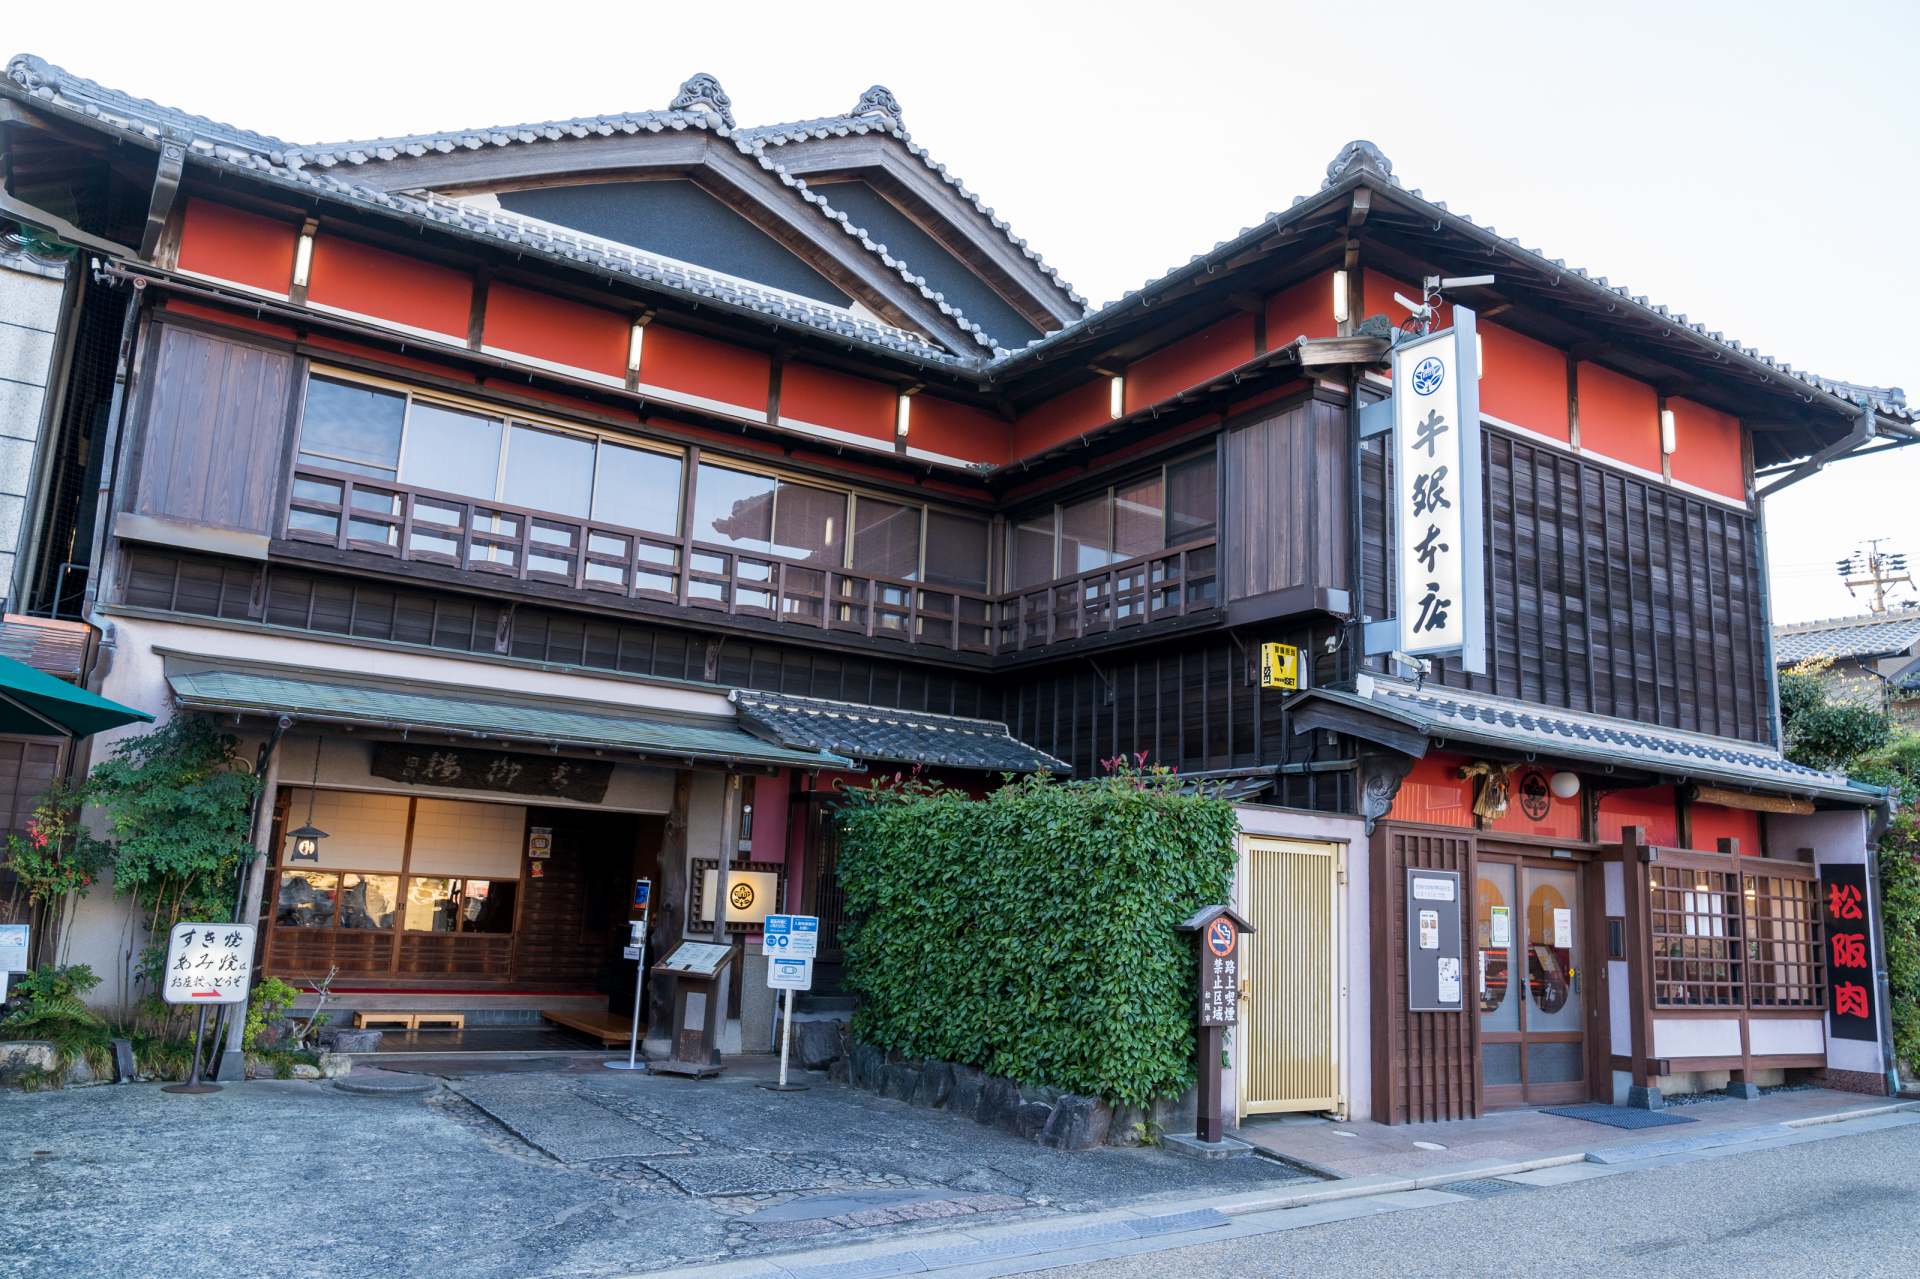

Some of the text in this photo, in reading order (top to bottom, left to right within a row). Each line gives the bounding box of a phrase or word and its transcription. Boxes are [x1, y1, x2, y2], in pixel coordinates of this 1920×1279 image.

[1411, 409, 1451, 634] 牛銀本店
[179, 928, 243, 948] すき焼
[1829, 884, 1869, 1018] 松阪肉
[1212, 958, 1223, 1021] 禁止区域
[1225, 960, 1236, 1021] 路上喫煙
